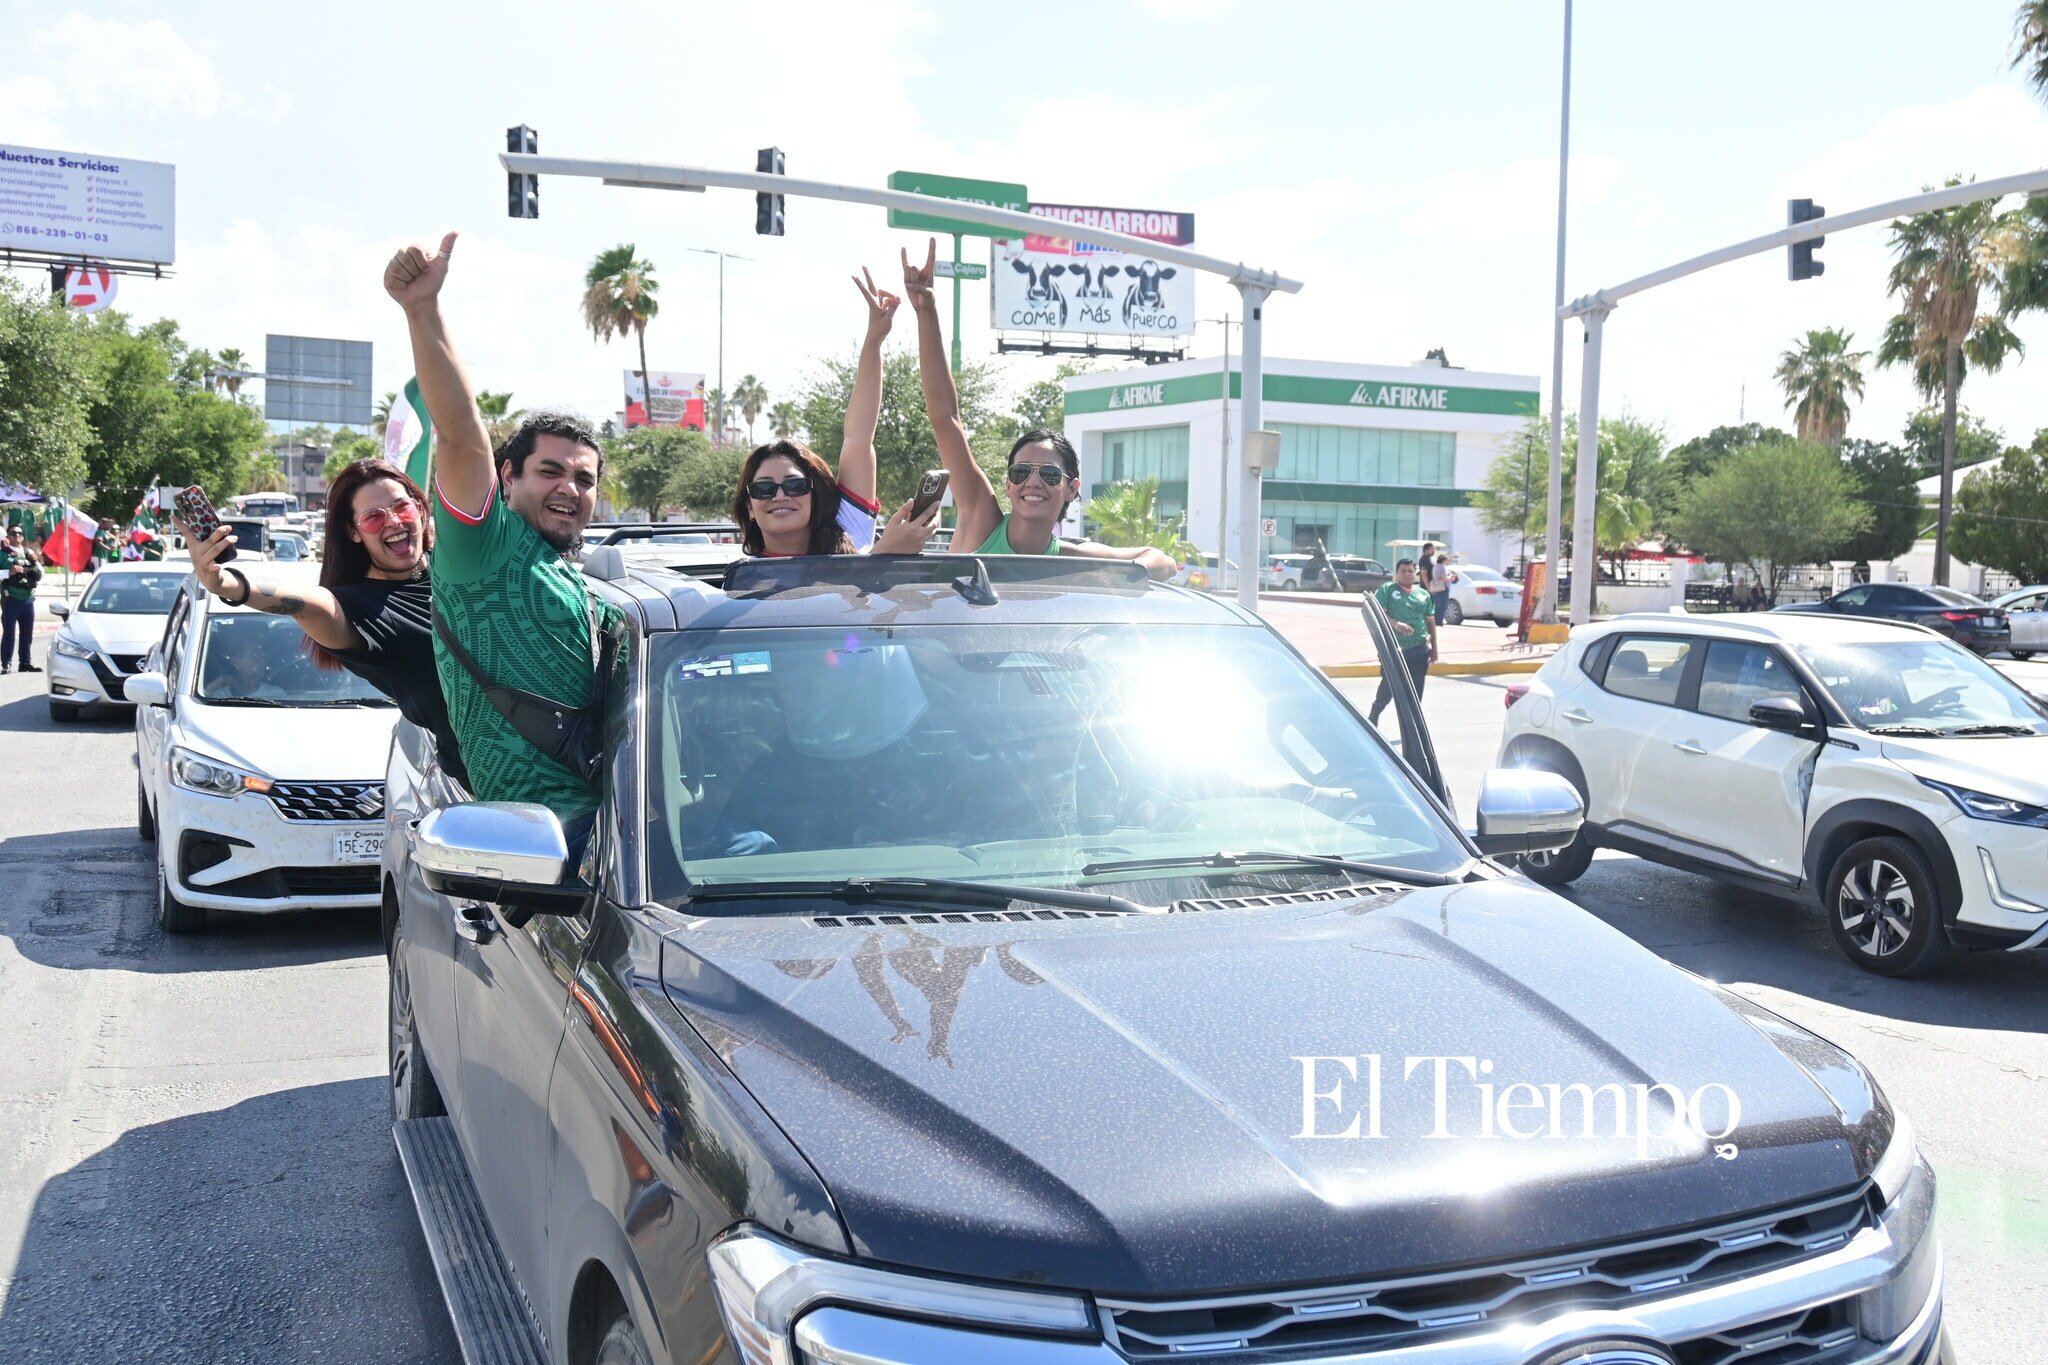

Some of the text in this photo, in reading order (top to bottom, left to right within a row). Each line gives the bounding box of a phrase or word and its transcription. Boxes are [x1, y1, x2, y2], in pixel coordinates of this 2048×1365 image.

[0, 150, 120, 173] Nuestros Servicios:
[95, 176, 121, 186] Rayos
[95, 187, 143, 198] Ultrasonido
[15, 225, 109, 242] 866-239-01-03
[954, 263, 985, 275] Cajero
[1122, 384, 1165, 406] AFIRME
[1375, 384, 1448, 409] AFIRME
